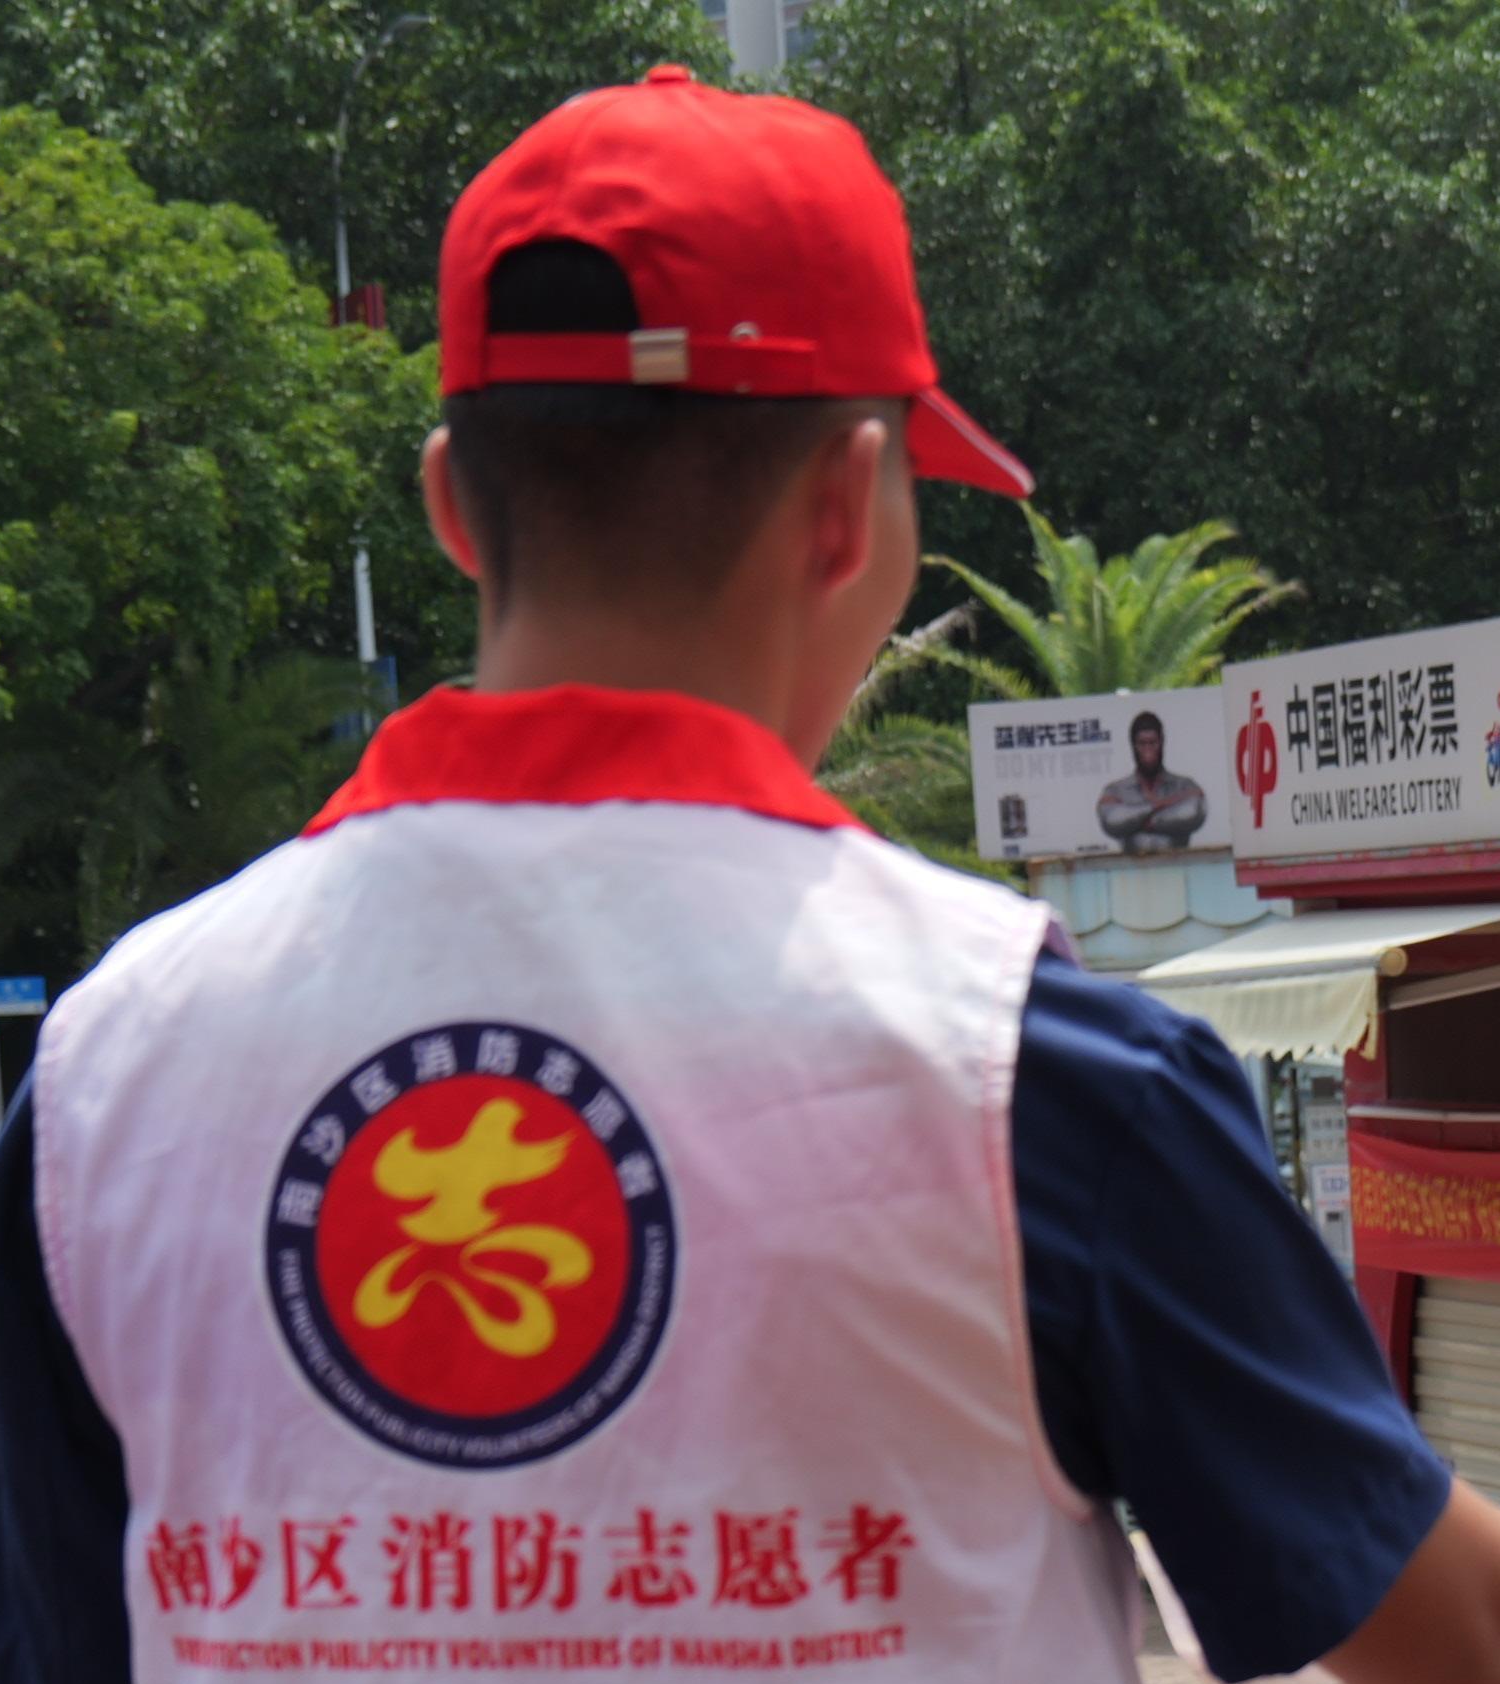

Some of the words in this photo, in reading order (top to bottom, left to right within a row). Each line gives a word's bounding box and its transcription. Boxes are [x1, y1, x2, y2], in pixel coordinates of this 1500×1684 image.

[1285, 663, 1459, 773] 中国福利彩票
[1291, 793, 1334, 825] CHINA
[1336, 783, 1398, 821] WELFARE
[1401, 776, 1463, 816] LOTTERY
[310, 1638, 438, 1671] PUBLICITY
[445, 1637, 621, 1671] VOLUNTEERS
[628, 1637, 662, 1669] OF
[669, 1637, 783, 1669] NANSHA
[791, 1624, 906, 1669] DISTRICT
